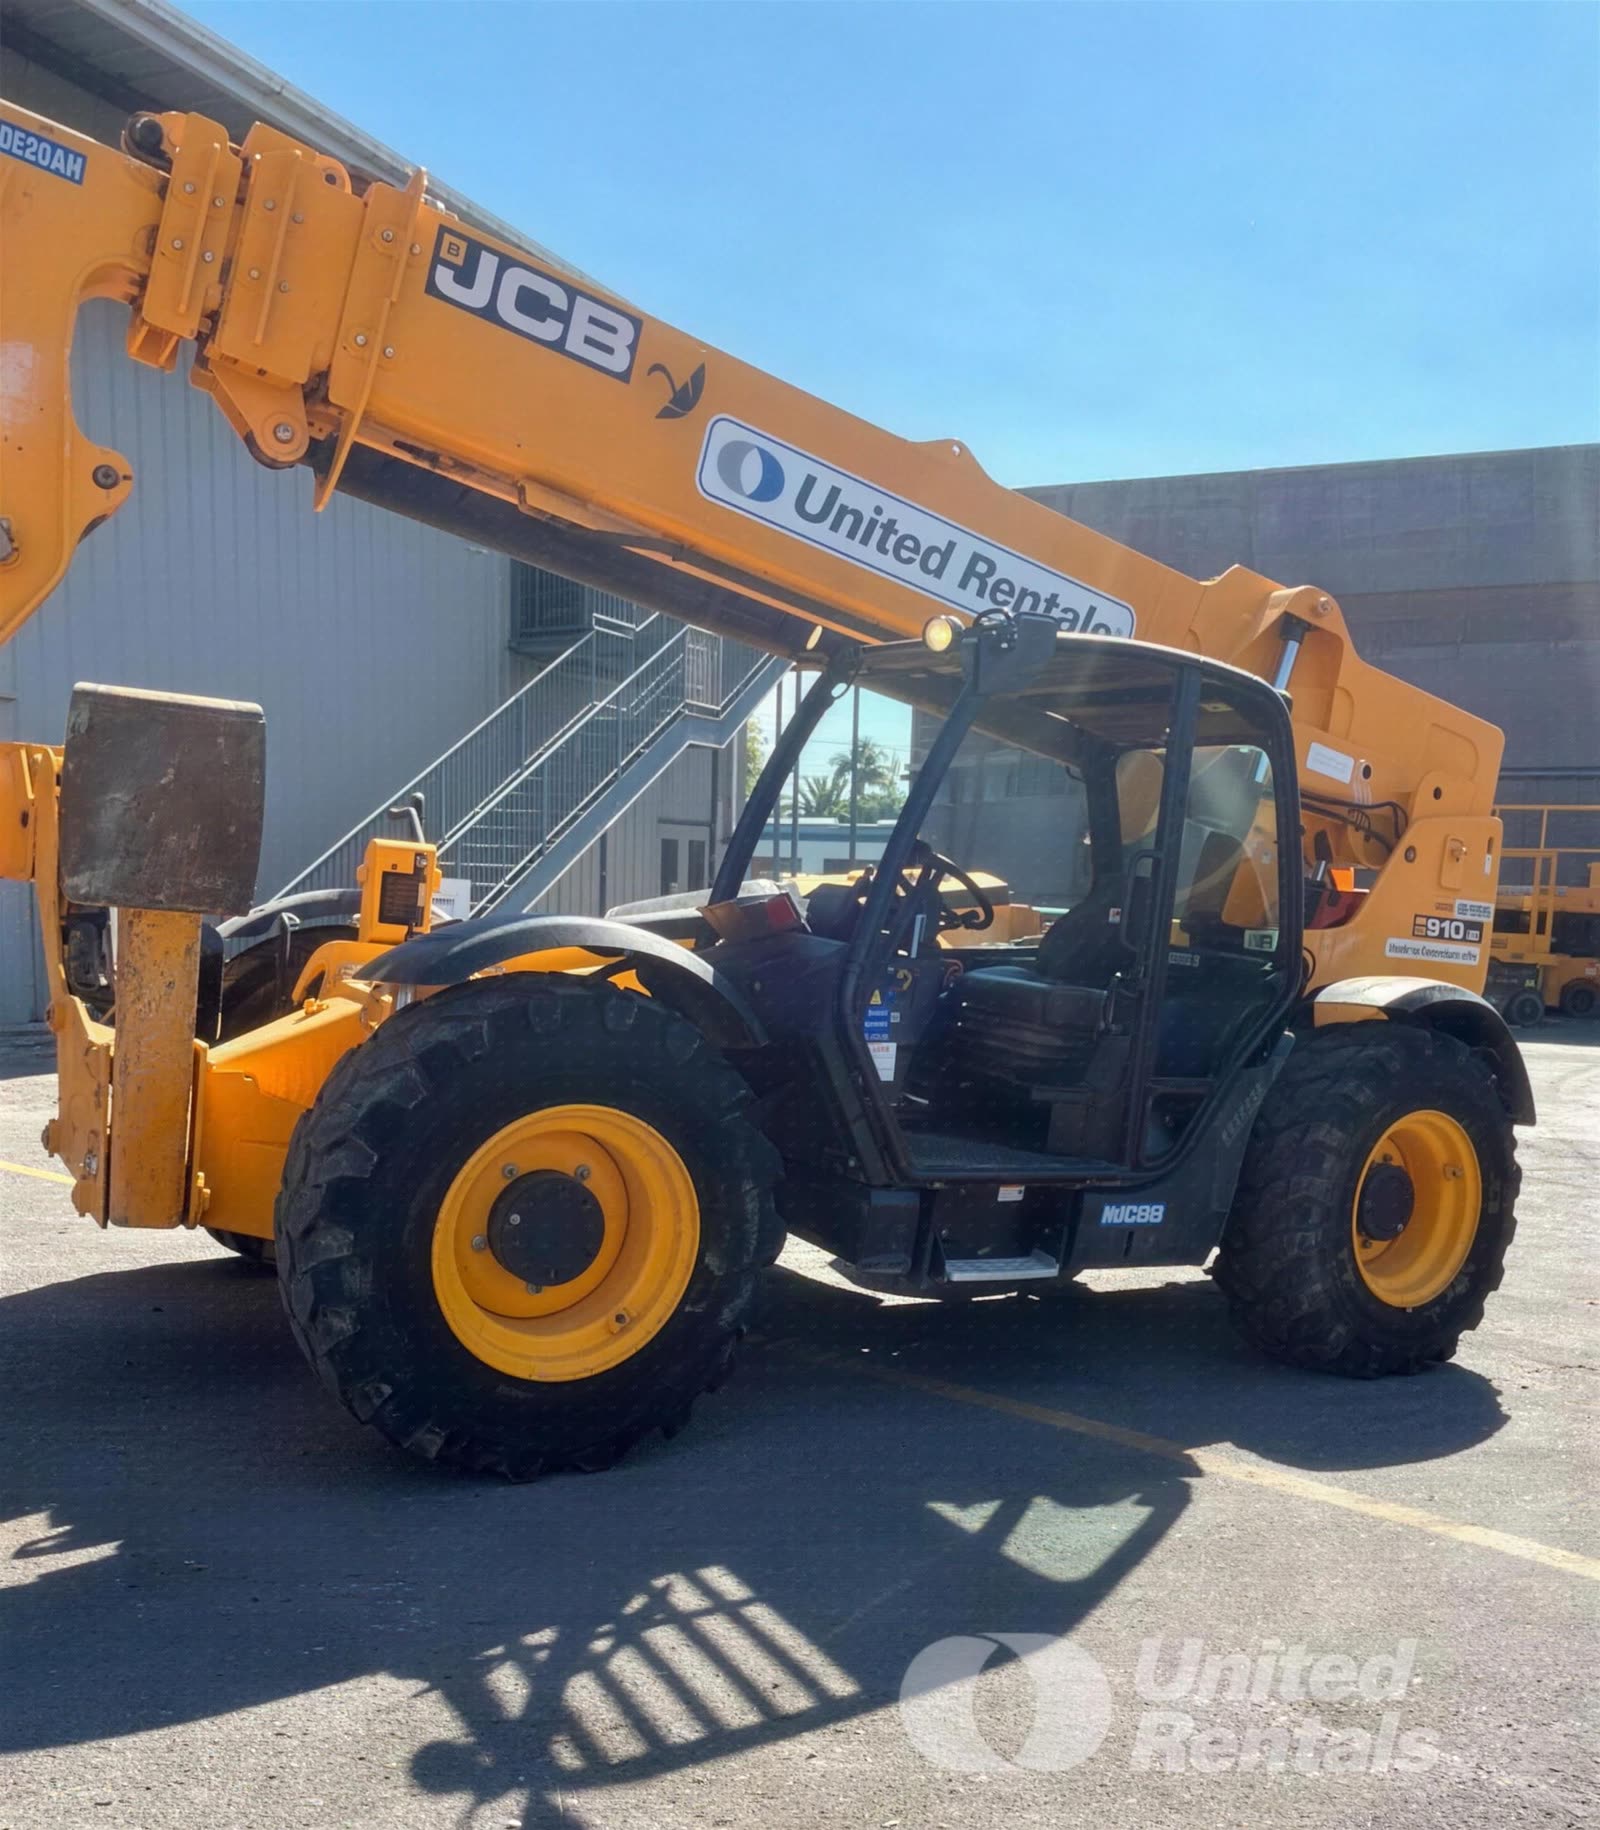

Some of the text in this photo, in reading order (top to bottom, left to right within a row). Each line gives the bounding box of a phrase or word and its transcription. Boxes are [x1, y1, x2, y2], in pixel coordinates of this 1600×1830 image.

[434, 250, 635, 373] JCB
[794, 473, 957, 579] United
[1427, 918, 1464, 939] 910
